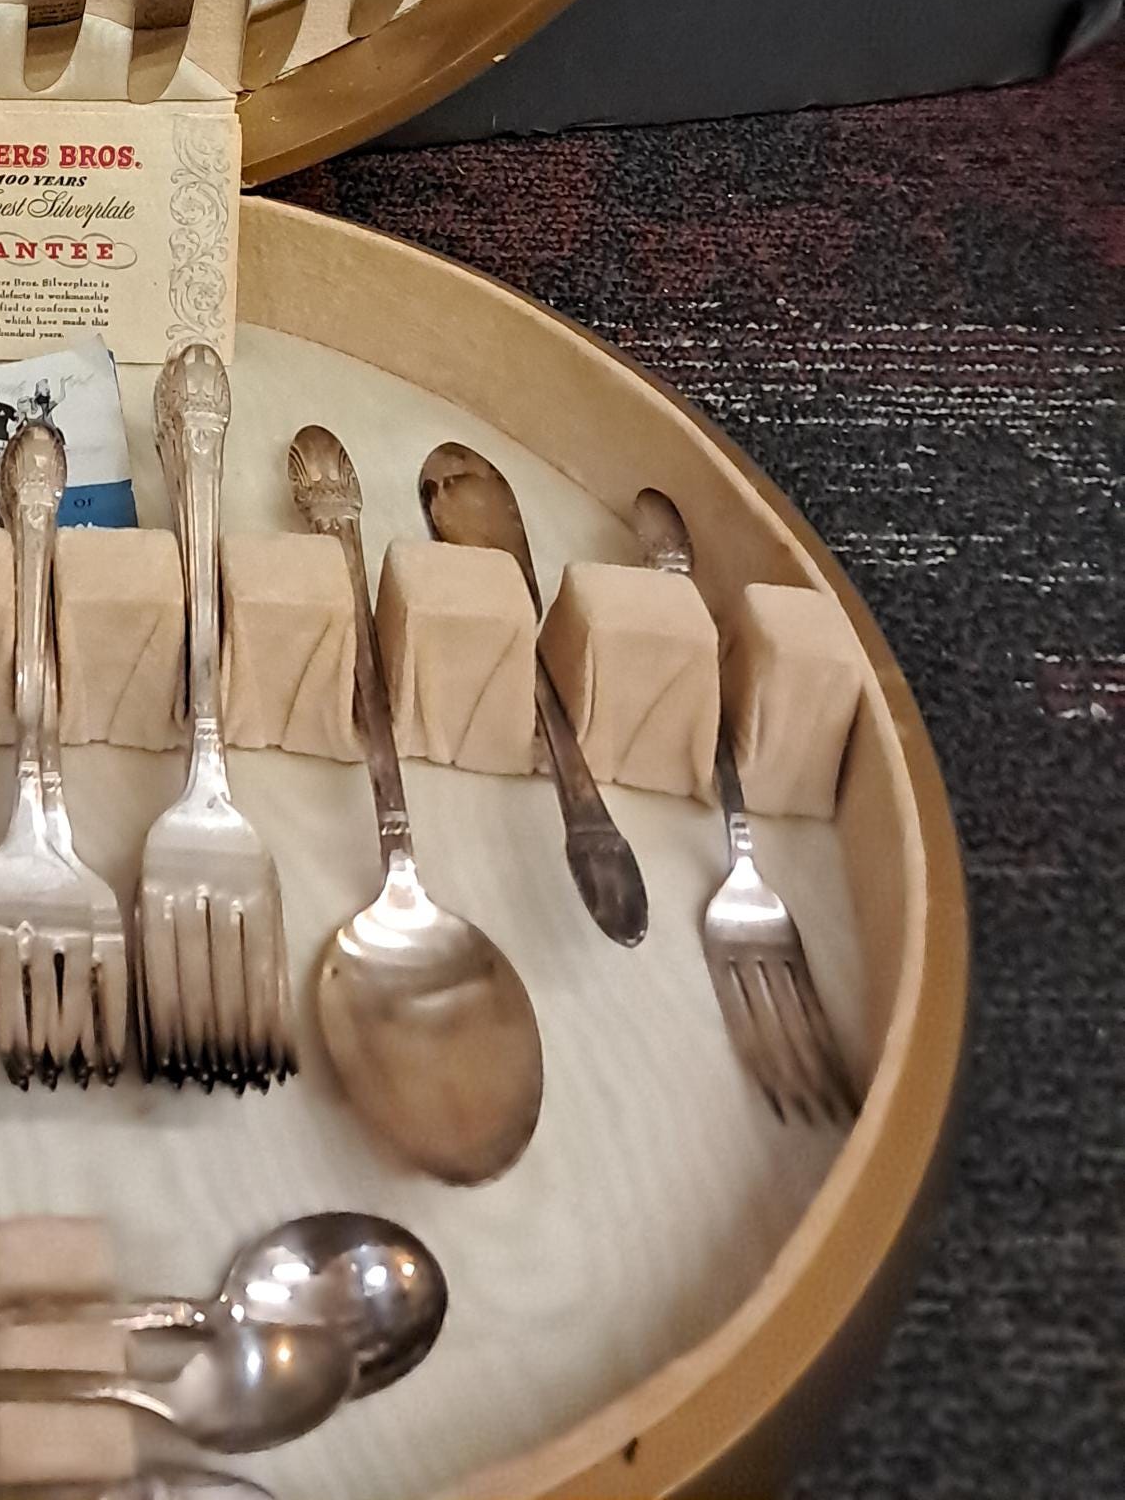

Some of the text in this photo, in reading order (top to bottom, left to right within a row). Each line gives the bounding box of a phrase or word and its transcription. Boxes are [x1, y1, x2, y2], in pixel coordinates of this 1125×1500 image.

[59, 144, 143, 169] BROS.
[33, 175, 87, 187] YEARS
[27, 190, 135, 228] Silverplate
[14, 278, 38, 287] Bros.
[42, 277, 98, 289] Silverplate
[101, 280, 109, 288] is
[0, 289, 30, 299] defects
[48, 290, 109, 302] workmanship
[35, 303, 77, 313] conform
[93, 304, 109, 313] the
[5, 315, 32, 325] which
[37, 316, 57, 325] have
[63, 316, 86, 325] made
[92, 317, 109, 326] this
